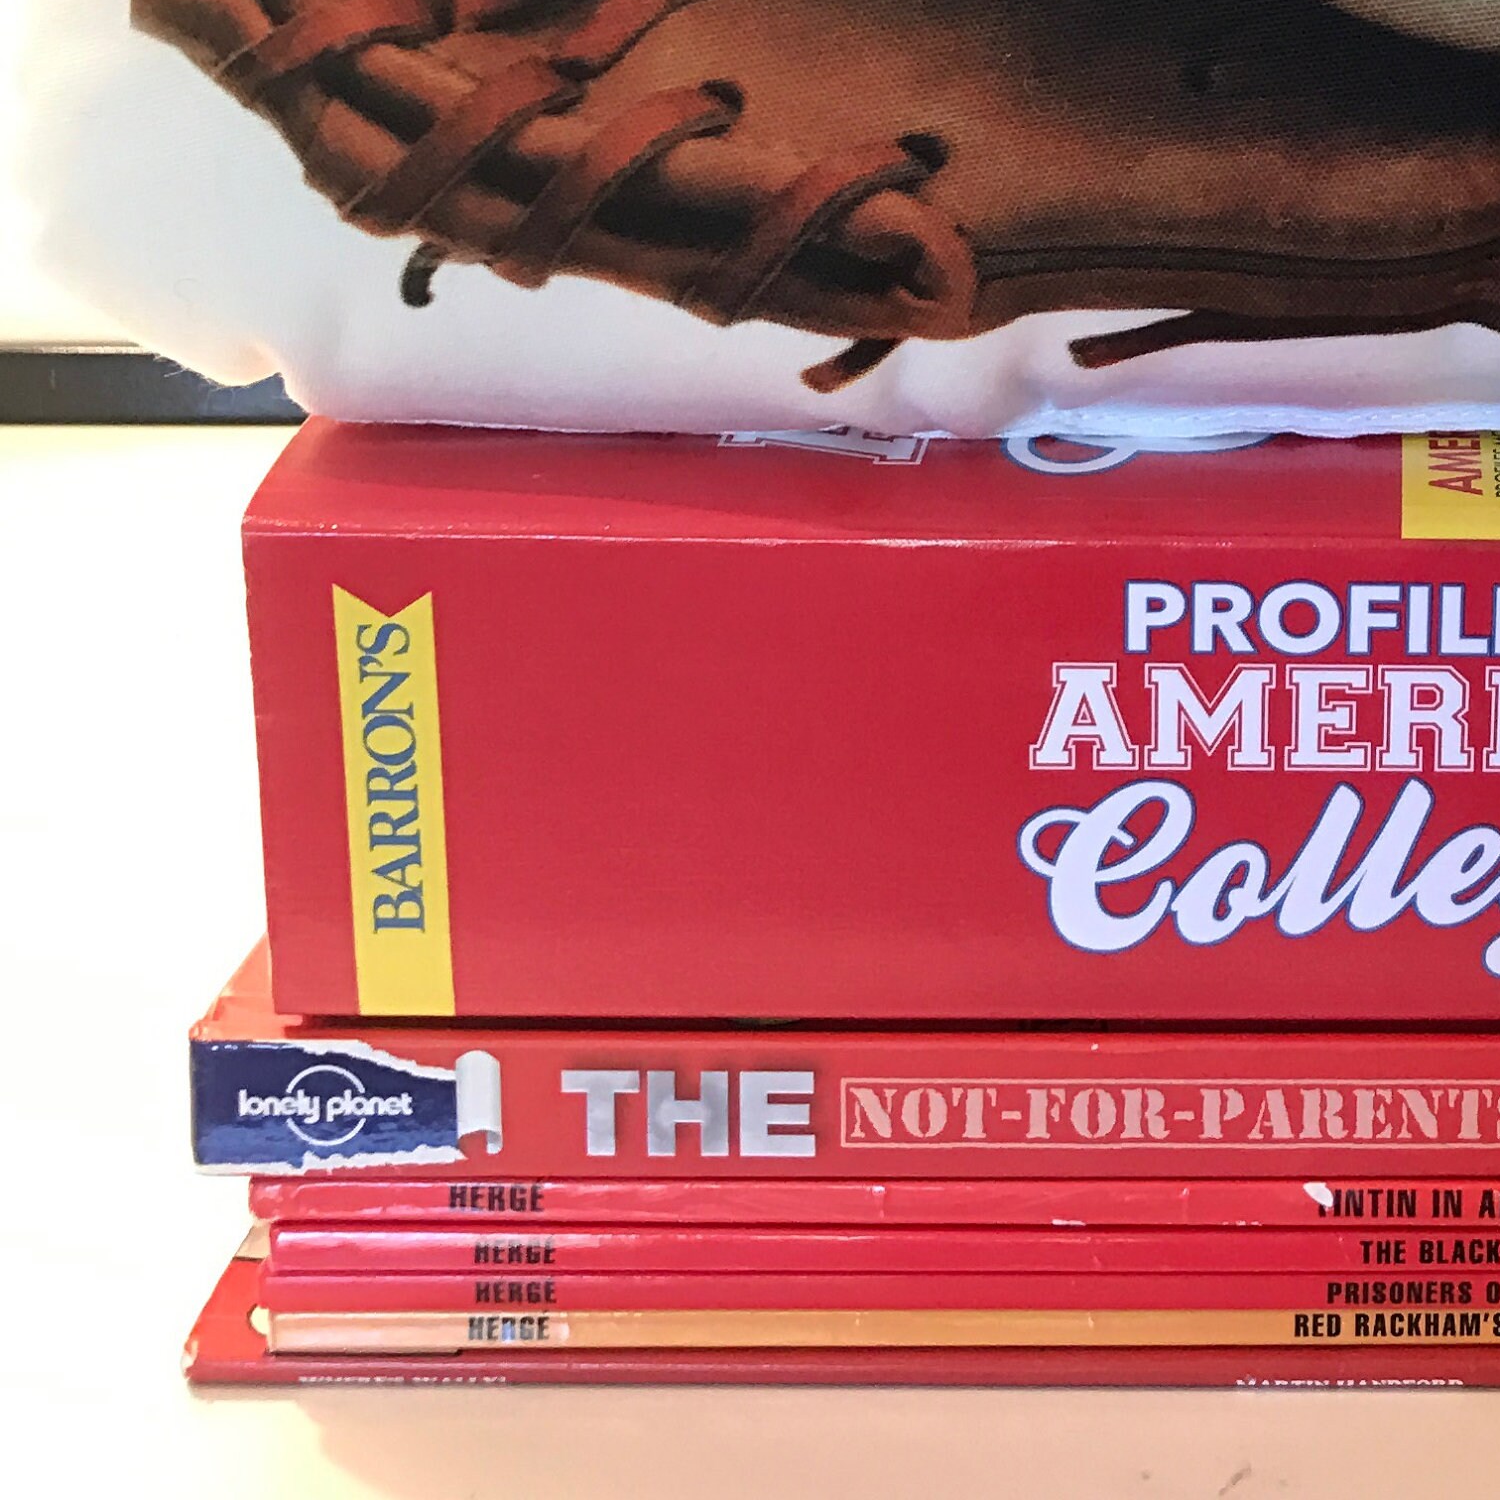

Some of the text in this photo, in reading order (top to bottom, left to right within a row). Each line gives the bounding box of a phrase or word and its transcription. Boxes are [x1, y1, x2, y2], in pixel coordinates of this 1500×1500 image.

[355, 621, 425, 934] BARRON'S
[238, 1089, 413, 1124] lonely planet
[561, 1069, 816, 1157] THE
[1432, 1188, 1462, 1218] IN
[1360, 1239, 1406, 1265] THE
[1418, 1239, 1500, 1265] BLACK
[1327, 1281, 1472, 1304] PRISONERS
[1294, 1313, 1341, 1338] RED
